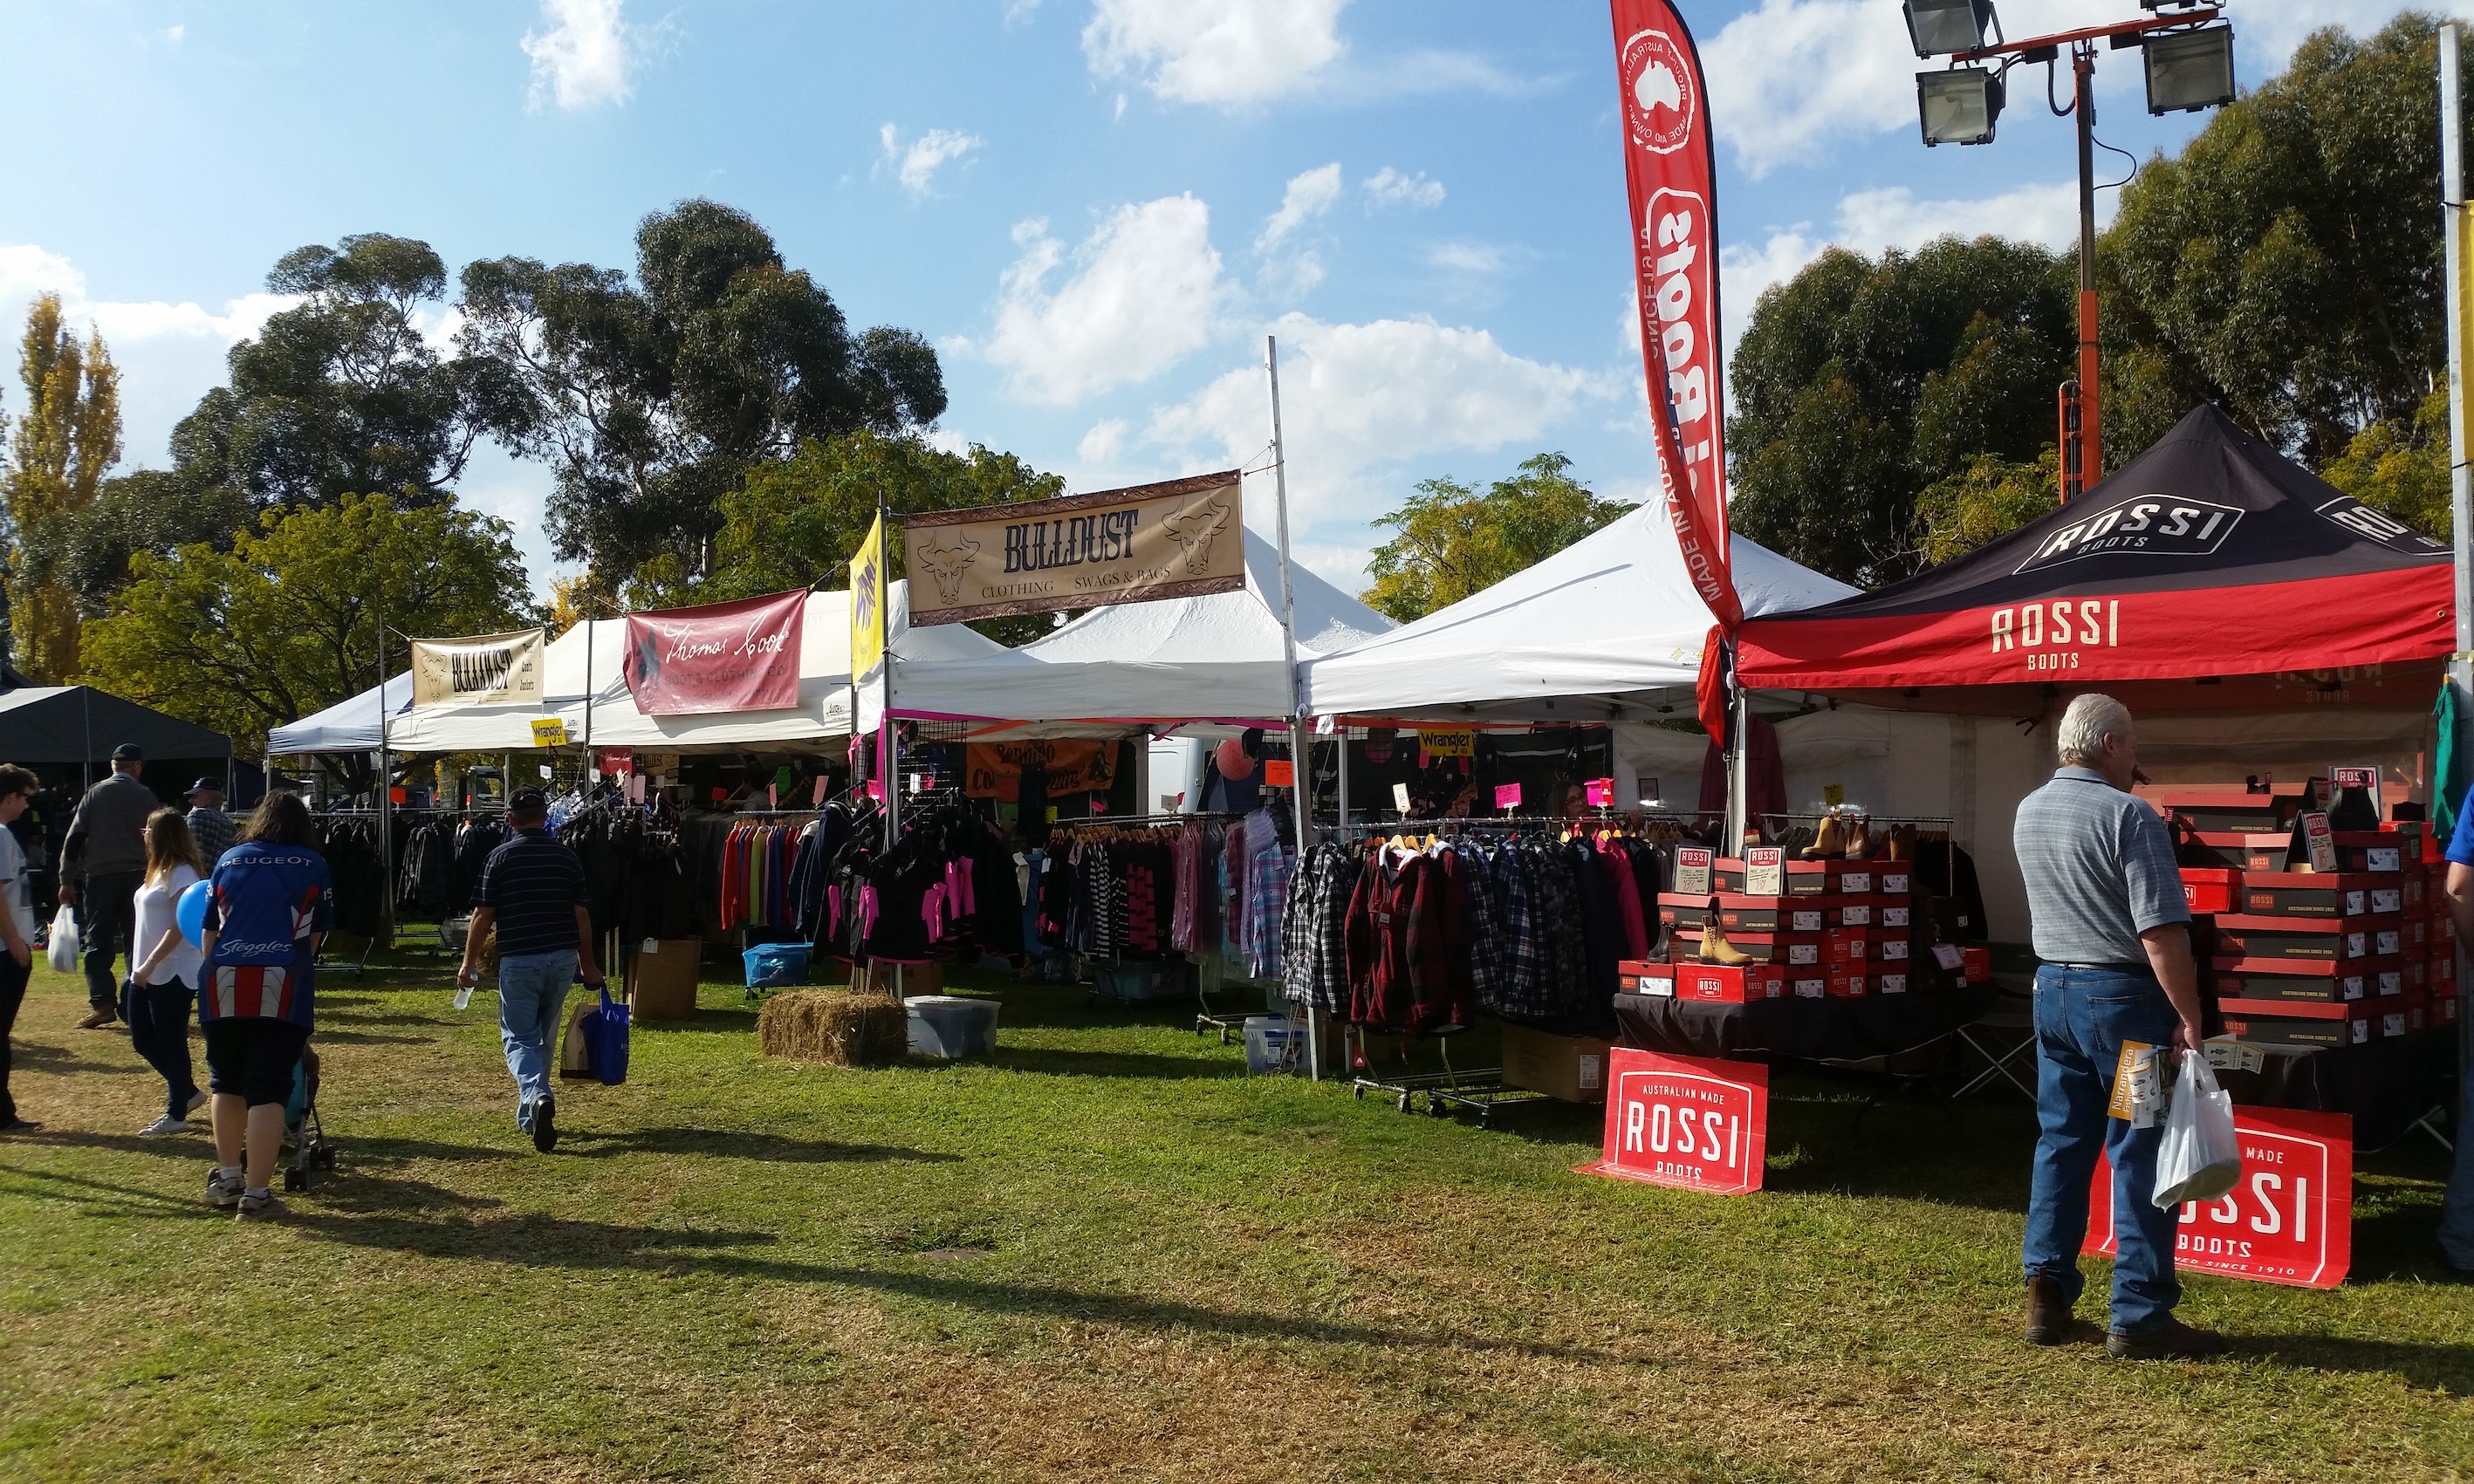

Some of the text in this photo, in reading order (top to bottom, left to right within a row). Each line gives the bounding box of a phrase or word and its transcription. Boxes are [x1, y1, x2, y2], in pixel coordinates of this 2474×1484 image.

[1672, 510, 1691, 534] IN
[2040, 503, 2225, 559] ROSSI
[1004, 509, 1139, 573] BULLDUST
[2077, 536, 2148, 556] BOOTS
[1682, 537, 1723, 602] MADE
[982, 565, 1171, 599] CLOTHING SWAGS & BAGS
[1991, 599, 2119, 653] ROSSI
[663, 609, 789, 664] Thomas Cook
[451, 648, 513, 693] BULLDUST
[2027, 653, 2079, 671] BOOTS
[665, 665, 785, 686] BOOT & CLOTHING CO
[531, 723, 563, 743] Wrangler
[1421, 732, 1470, 755] Wrangler
[2340, 770, 2373, 783] ROSI
[2307, 817, 2328, 831] ROSSI
[221, 856, 313, 871] PEUGEOT
[1681, 851, 1708, 863] ROSSI
[1751, 851, 1778, 862] ROSSI
[2251, 895, 2272, 904] ROSSI
[216, 939, 294, 958] Steggles
[1621, 977, 1636, 986] ROSSI
[1699, 980, 1720, 991] ROSSI
[2112, 1049, 2134, 1111] Narrandera
[1642, 1084, 1725, 1105] AUSTRALIAN MADE
[1626, 1100, 1739, 1168] ROSSI
[2246, 1146, 2285, 1165] MADE
[1655, 1160, 1703, 1180] BOOTS
[2179, 1172, 2307, 1242] SSI
[2177, 1234, 2253, 1259] BOOTS
[2205, 1259, 2249, 1272] SINCE
[2258, 1266, 2296, 1276] 1910
